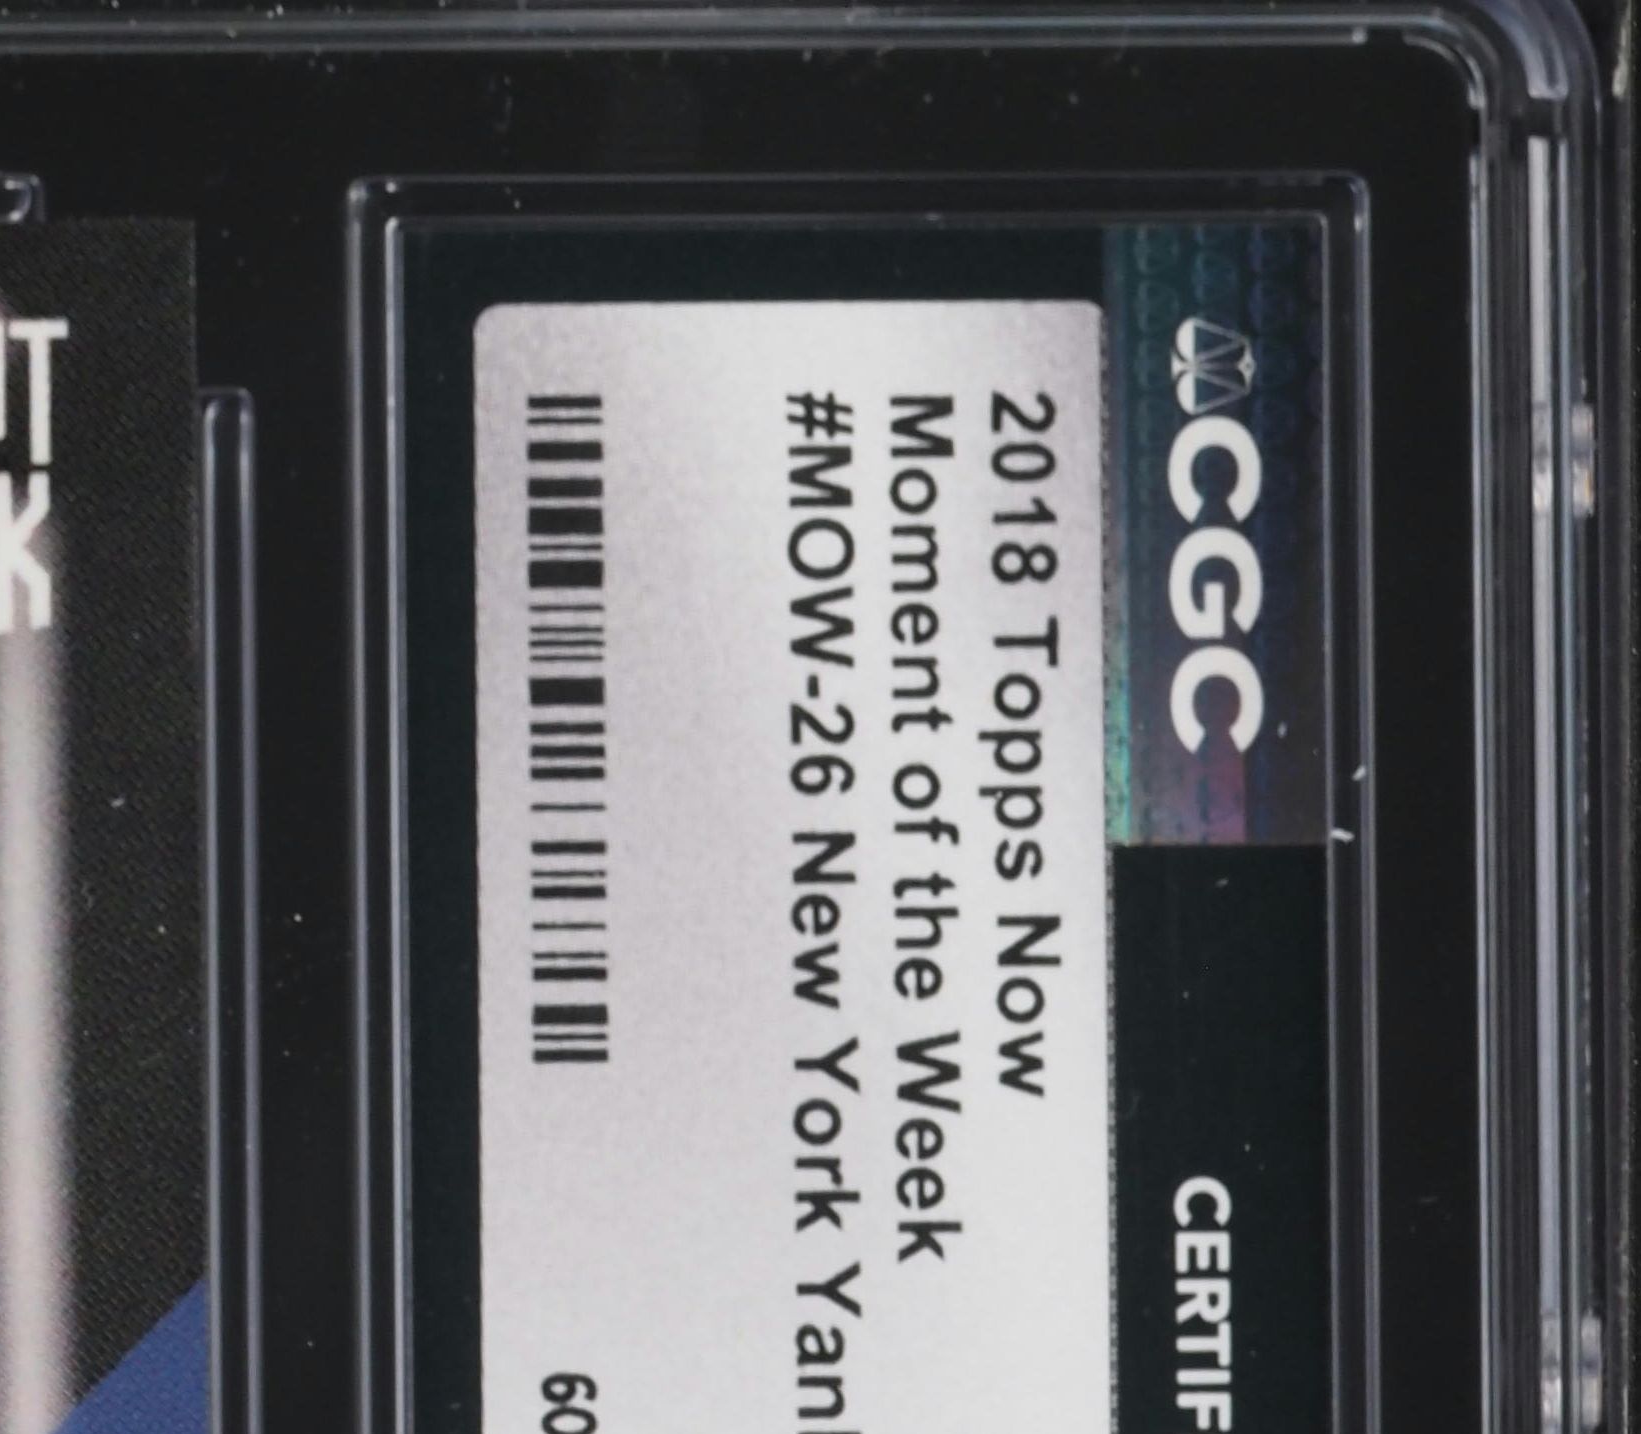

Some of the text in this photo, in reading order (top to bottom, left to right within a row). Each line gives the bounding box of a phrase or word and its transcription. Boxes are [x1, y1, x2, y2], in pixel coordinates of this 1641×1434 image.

[785, 391, 857, 798] #MOW-26
[977, 390, 1063, 1098] 2018 Topps Now
[1167, 414, 1264, 755] CGC
[789, 829, 859, 1011] New
[888, 394, 964, 1263] Moment of the Week
[791, 1036, 862, 1234] York
